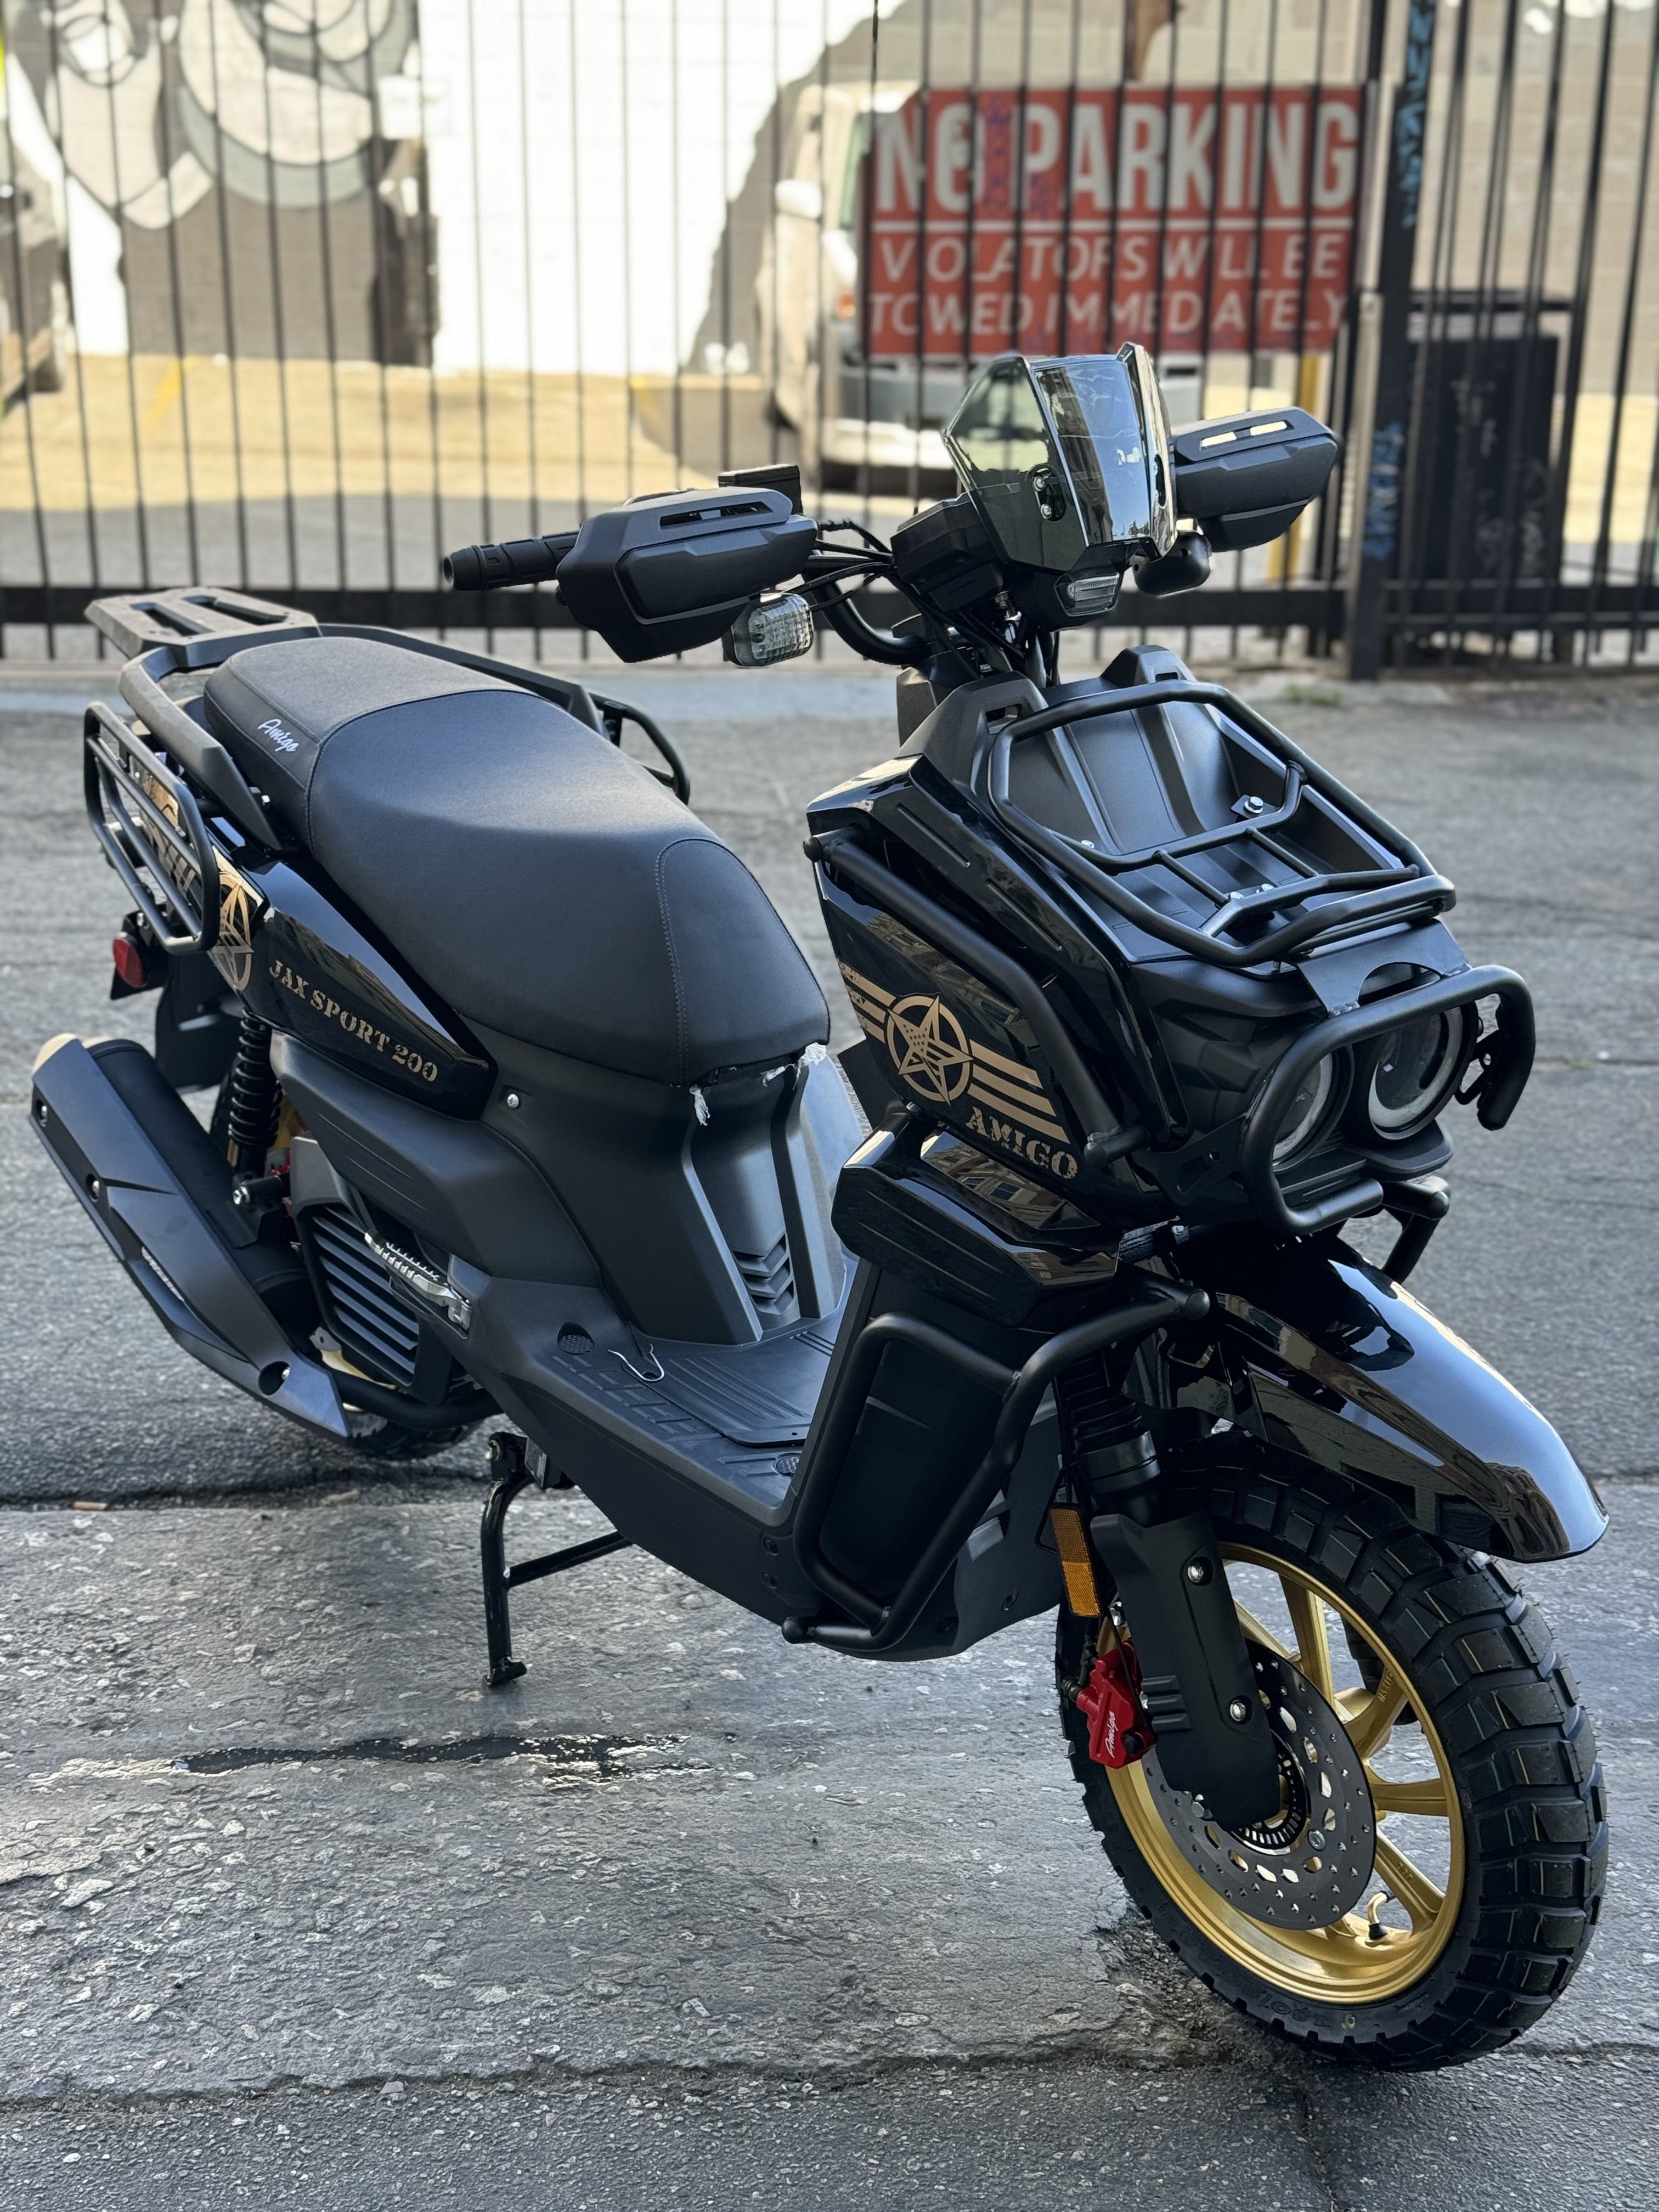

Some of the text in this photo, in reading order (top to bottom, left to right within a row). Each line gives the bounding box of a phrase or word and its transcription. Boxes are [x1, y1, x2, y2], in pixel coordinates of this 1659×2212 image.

[875, 101, 986, 213] NO
[1011, 100, 1359, 212] PARKING
[257, 718, 300, 753] Amigo
[269, 957, 439, 1083] JAX SPORT 200
[965, 1105, 1079, 1180] AMIGO
[1105, 1711, 1119, 1758] Amigo
